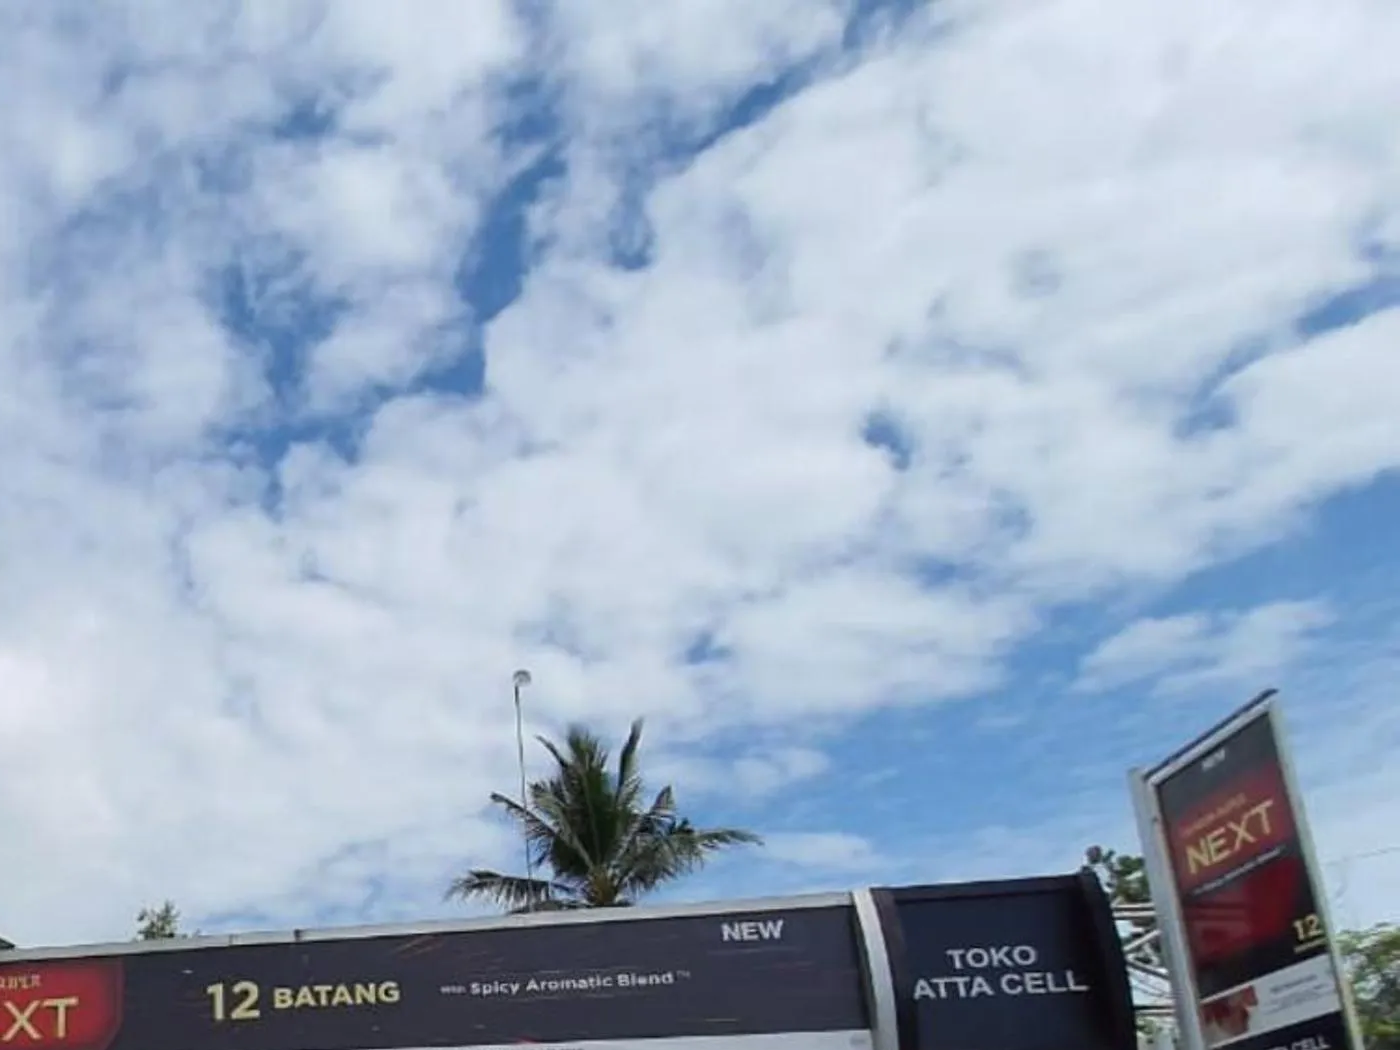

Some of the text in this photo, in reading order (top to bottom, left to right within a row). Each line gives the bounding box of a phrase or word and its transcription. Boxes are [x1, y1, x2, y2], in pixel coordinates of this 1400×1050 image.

[1186, 799, 1273, 874] NEXT
[721, 919, 784, 942] NEW
[1293, 914, 1322, 940] 12
[946, 944, 1037, 970] TOKO
[470, 981, 521, 997] Spicy
[526, 976, 613, 993] Aromatic
[913, 970, 1089, 1001] ATTA CELL
[206, 980, 400, 1021] 12 BATANG
